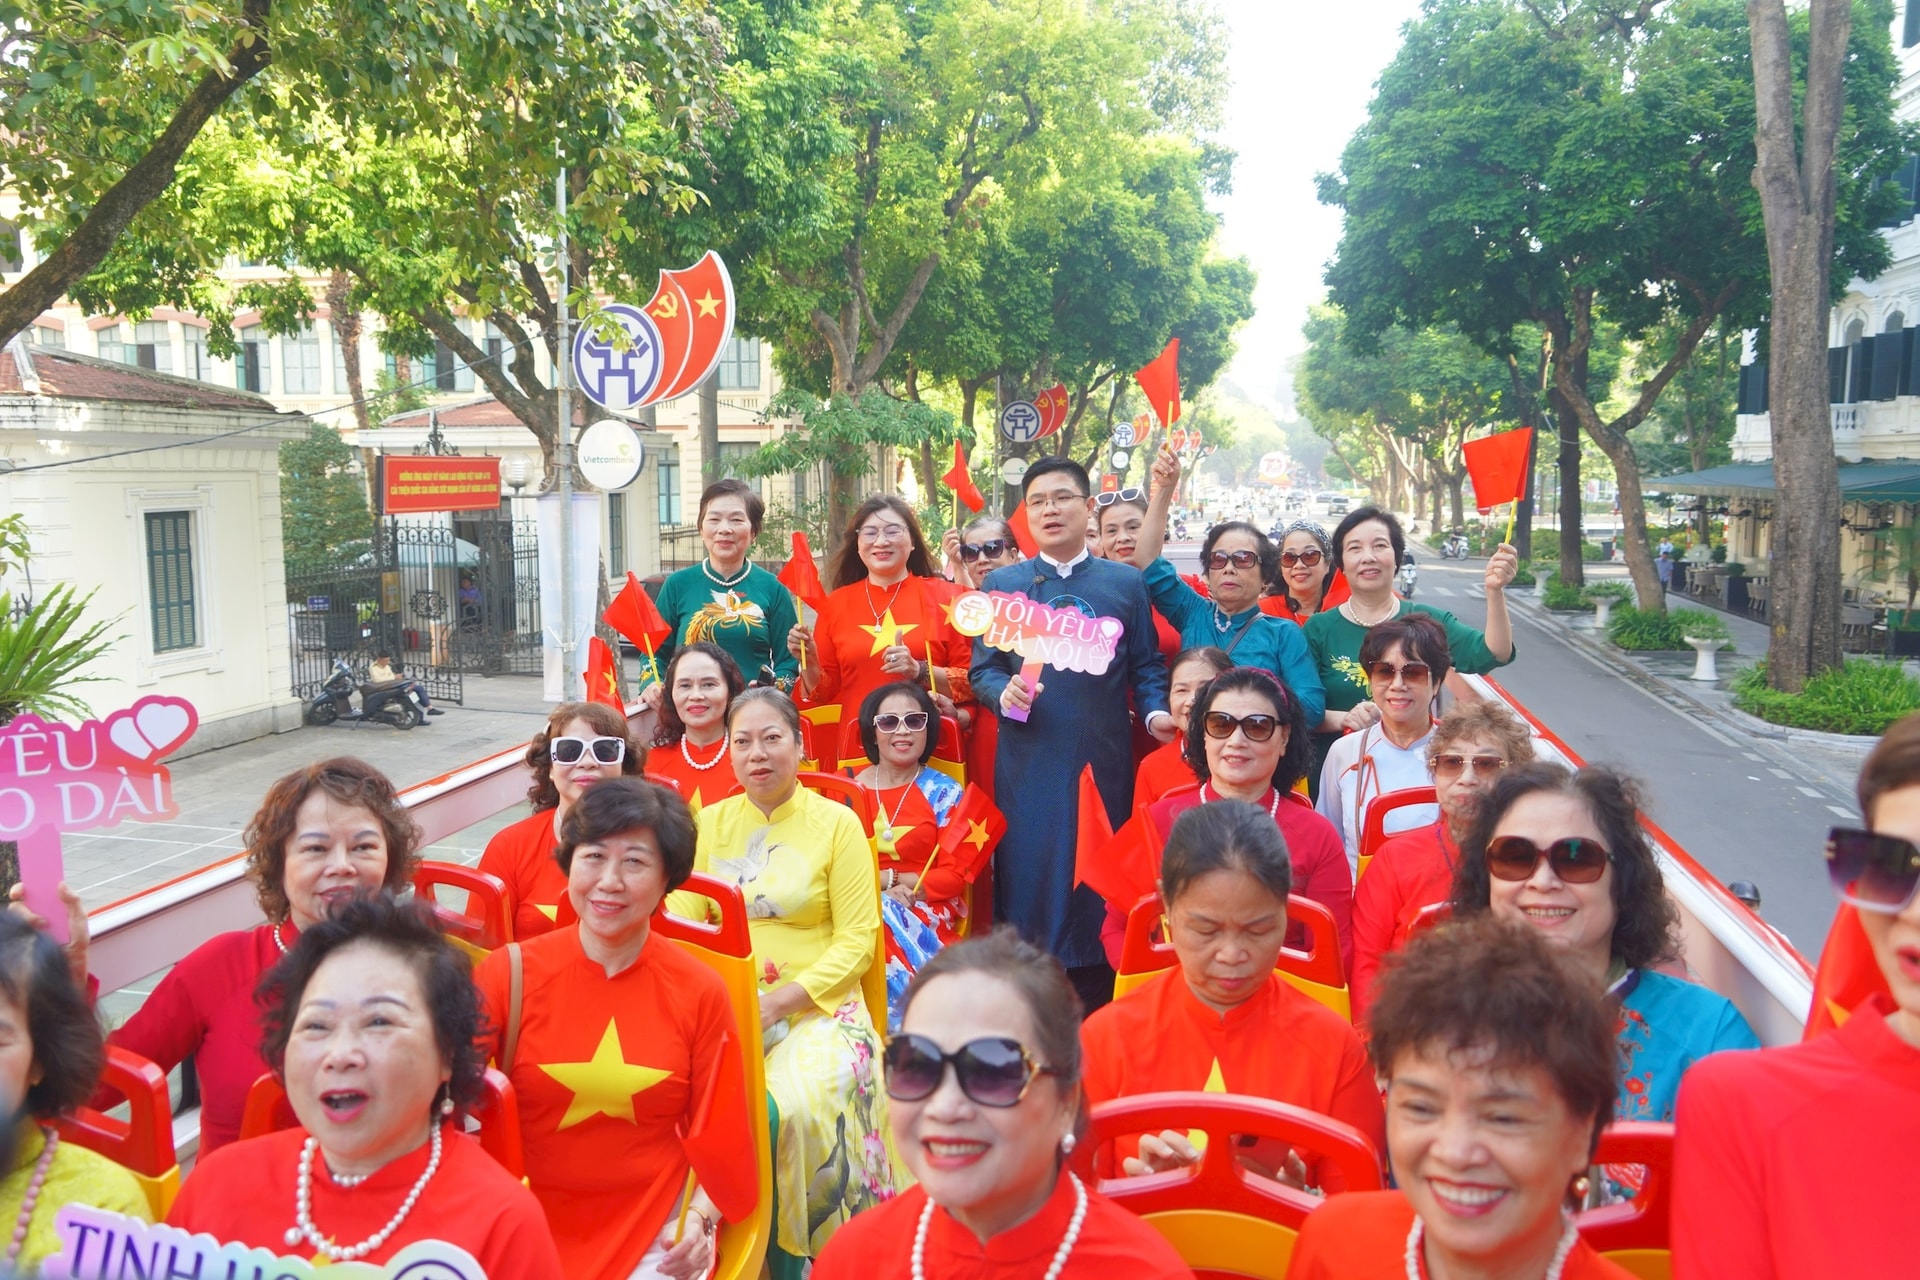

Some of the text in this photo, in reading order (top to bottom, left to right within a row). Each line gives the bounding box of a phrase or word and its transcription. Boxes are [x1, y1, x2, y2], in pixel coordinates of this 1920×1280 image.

[583, 456, 634, 464] Vietcombank
[991, 596, 1098, 643] TÔI YÊU
[988, 622, 1082, 667] HÀ NỘI
[0, 722, 98, 778] ÊU
[55, 766, 170, 825] DÀI
